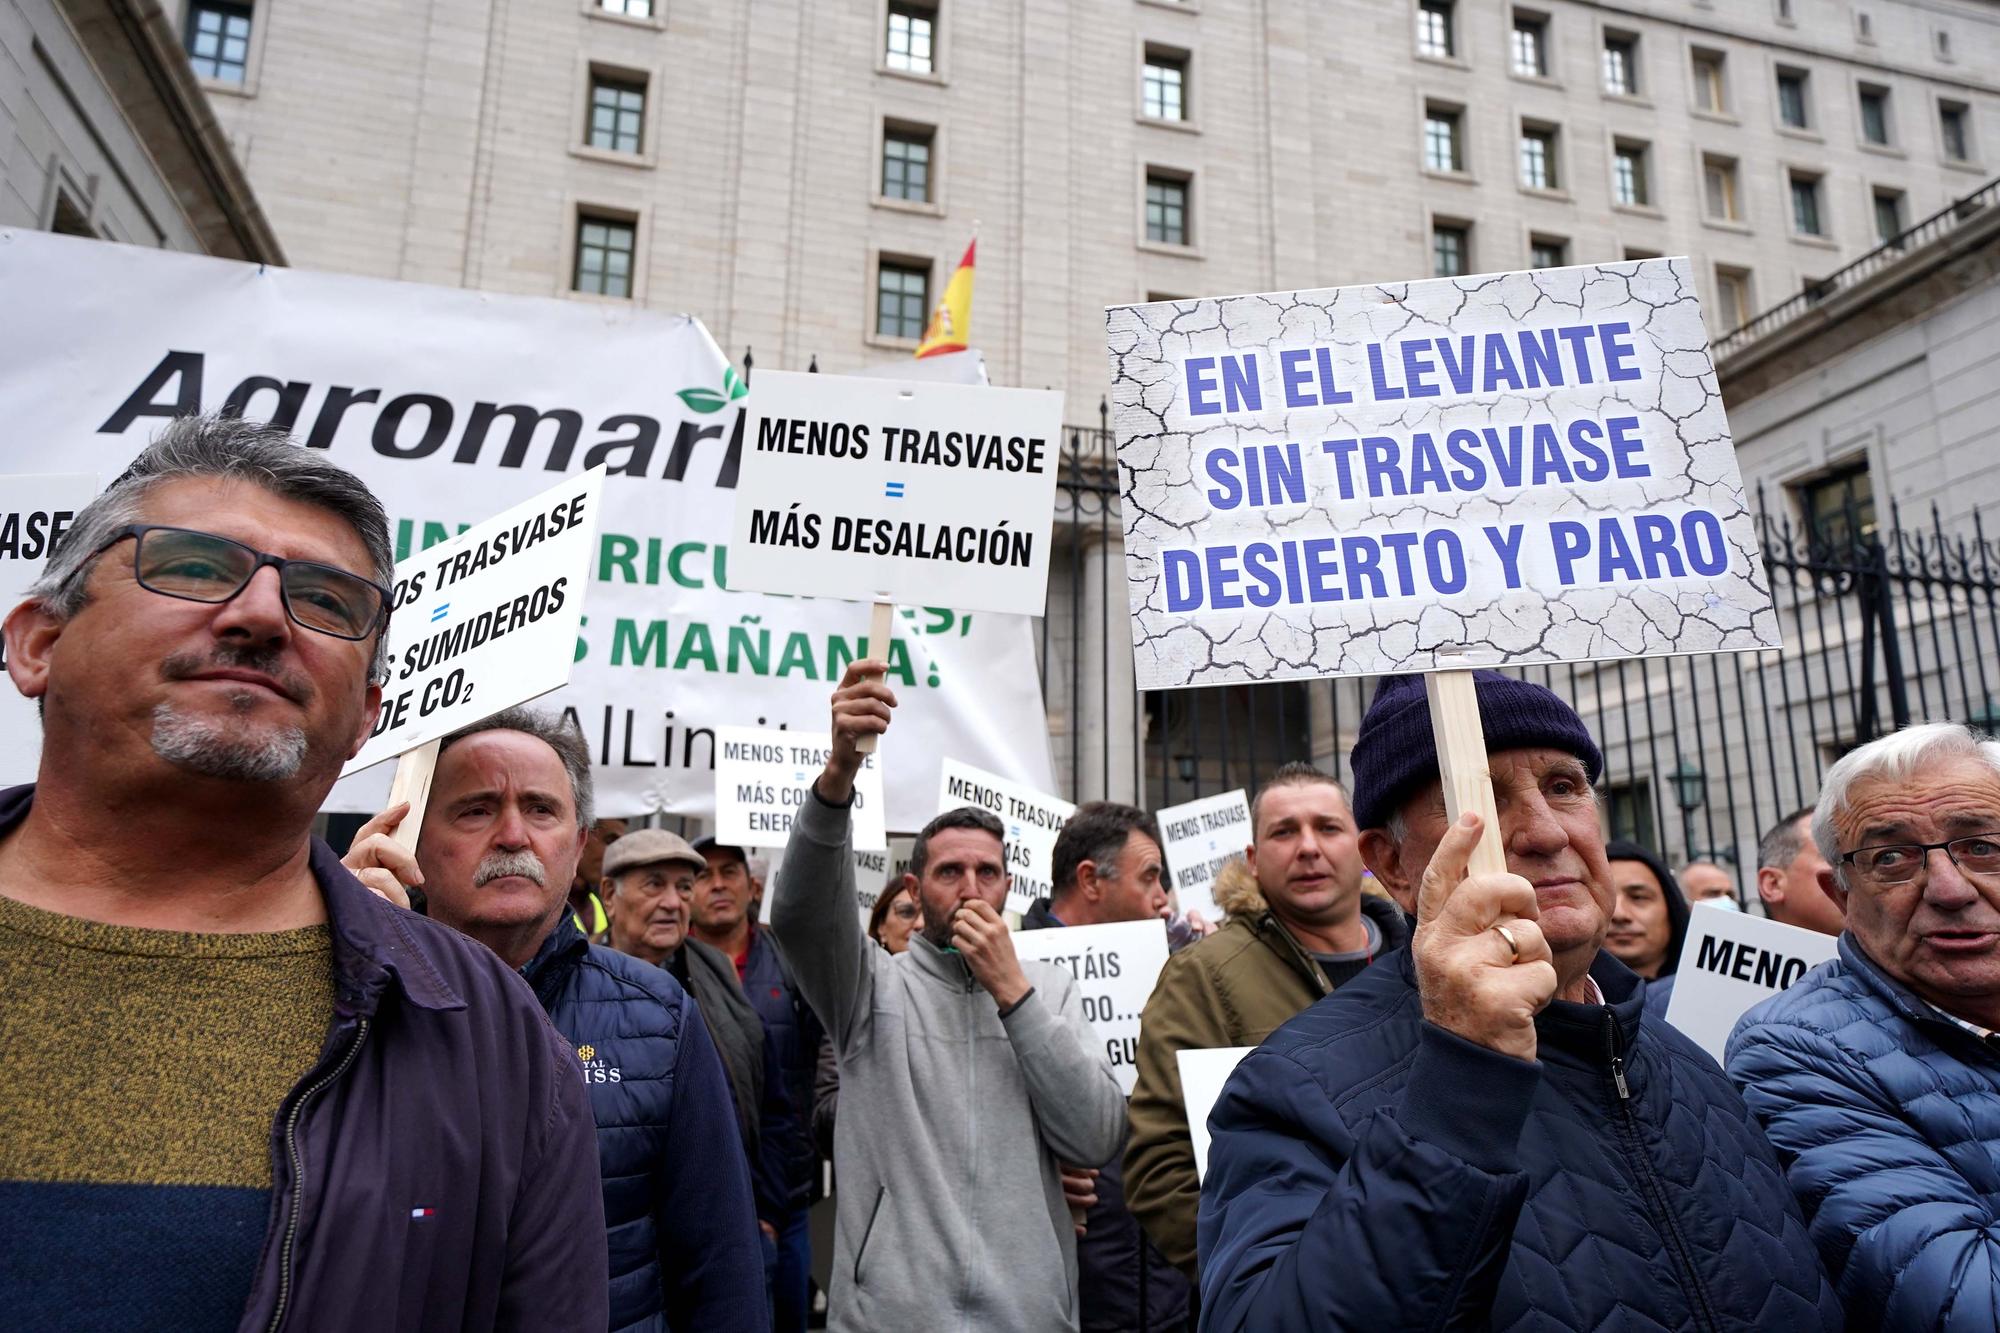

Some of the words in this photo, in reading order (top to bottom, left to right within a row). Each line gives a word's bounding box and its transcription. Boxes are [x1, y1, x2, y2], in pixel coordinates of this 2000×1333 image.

[1185, 353, 1263, 416] EN
[1281, 347, 1353, 409] EL
[1367, 321, 1642, 402] LEVANTE
[757, 417, 870, 460] MENOS
[882, 427, 1046, 474] TRASVASE
[1205, 442, 1307, 510] SIN
[1323, 416, 1652, 501] TRASVASE
[435, 492, 588, 591] TRASVASE
[749, 502, 822, 549] MÁS
[831, 516, 1033, 568] DESALACIÓN
[1163, 528, 1468, 613] DESIERTO
[1481, 523, 1525, 589] Y
[1549, 509, 1729, 586] PARO
[399, 577, 568, 680] SUMIDEROS
[724, 741, 784, 764] MENOS
[737, 780, 775, 806] MÁS
[948, 776, 1003, 812] MENOS
[1166, 817, 1201, 842] MENOS
[1201, 804, 1247, 832] TRASVASE
[1177, 862, 1209, 888] MENOS
[1696, 933, 1818, 991] MENO
